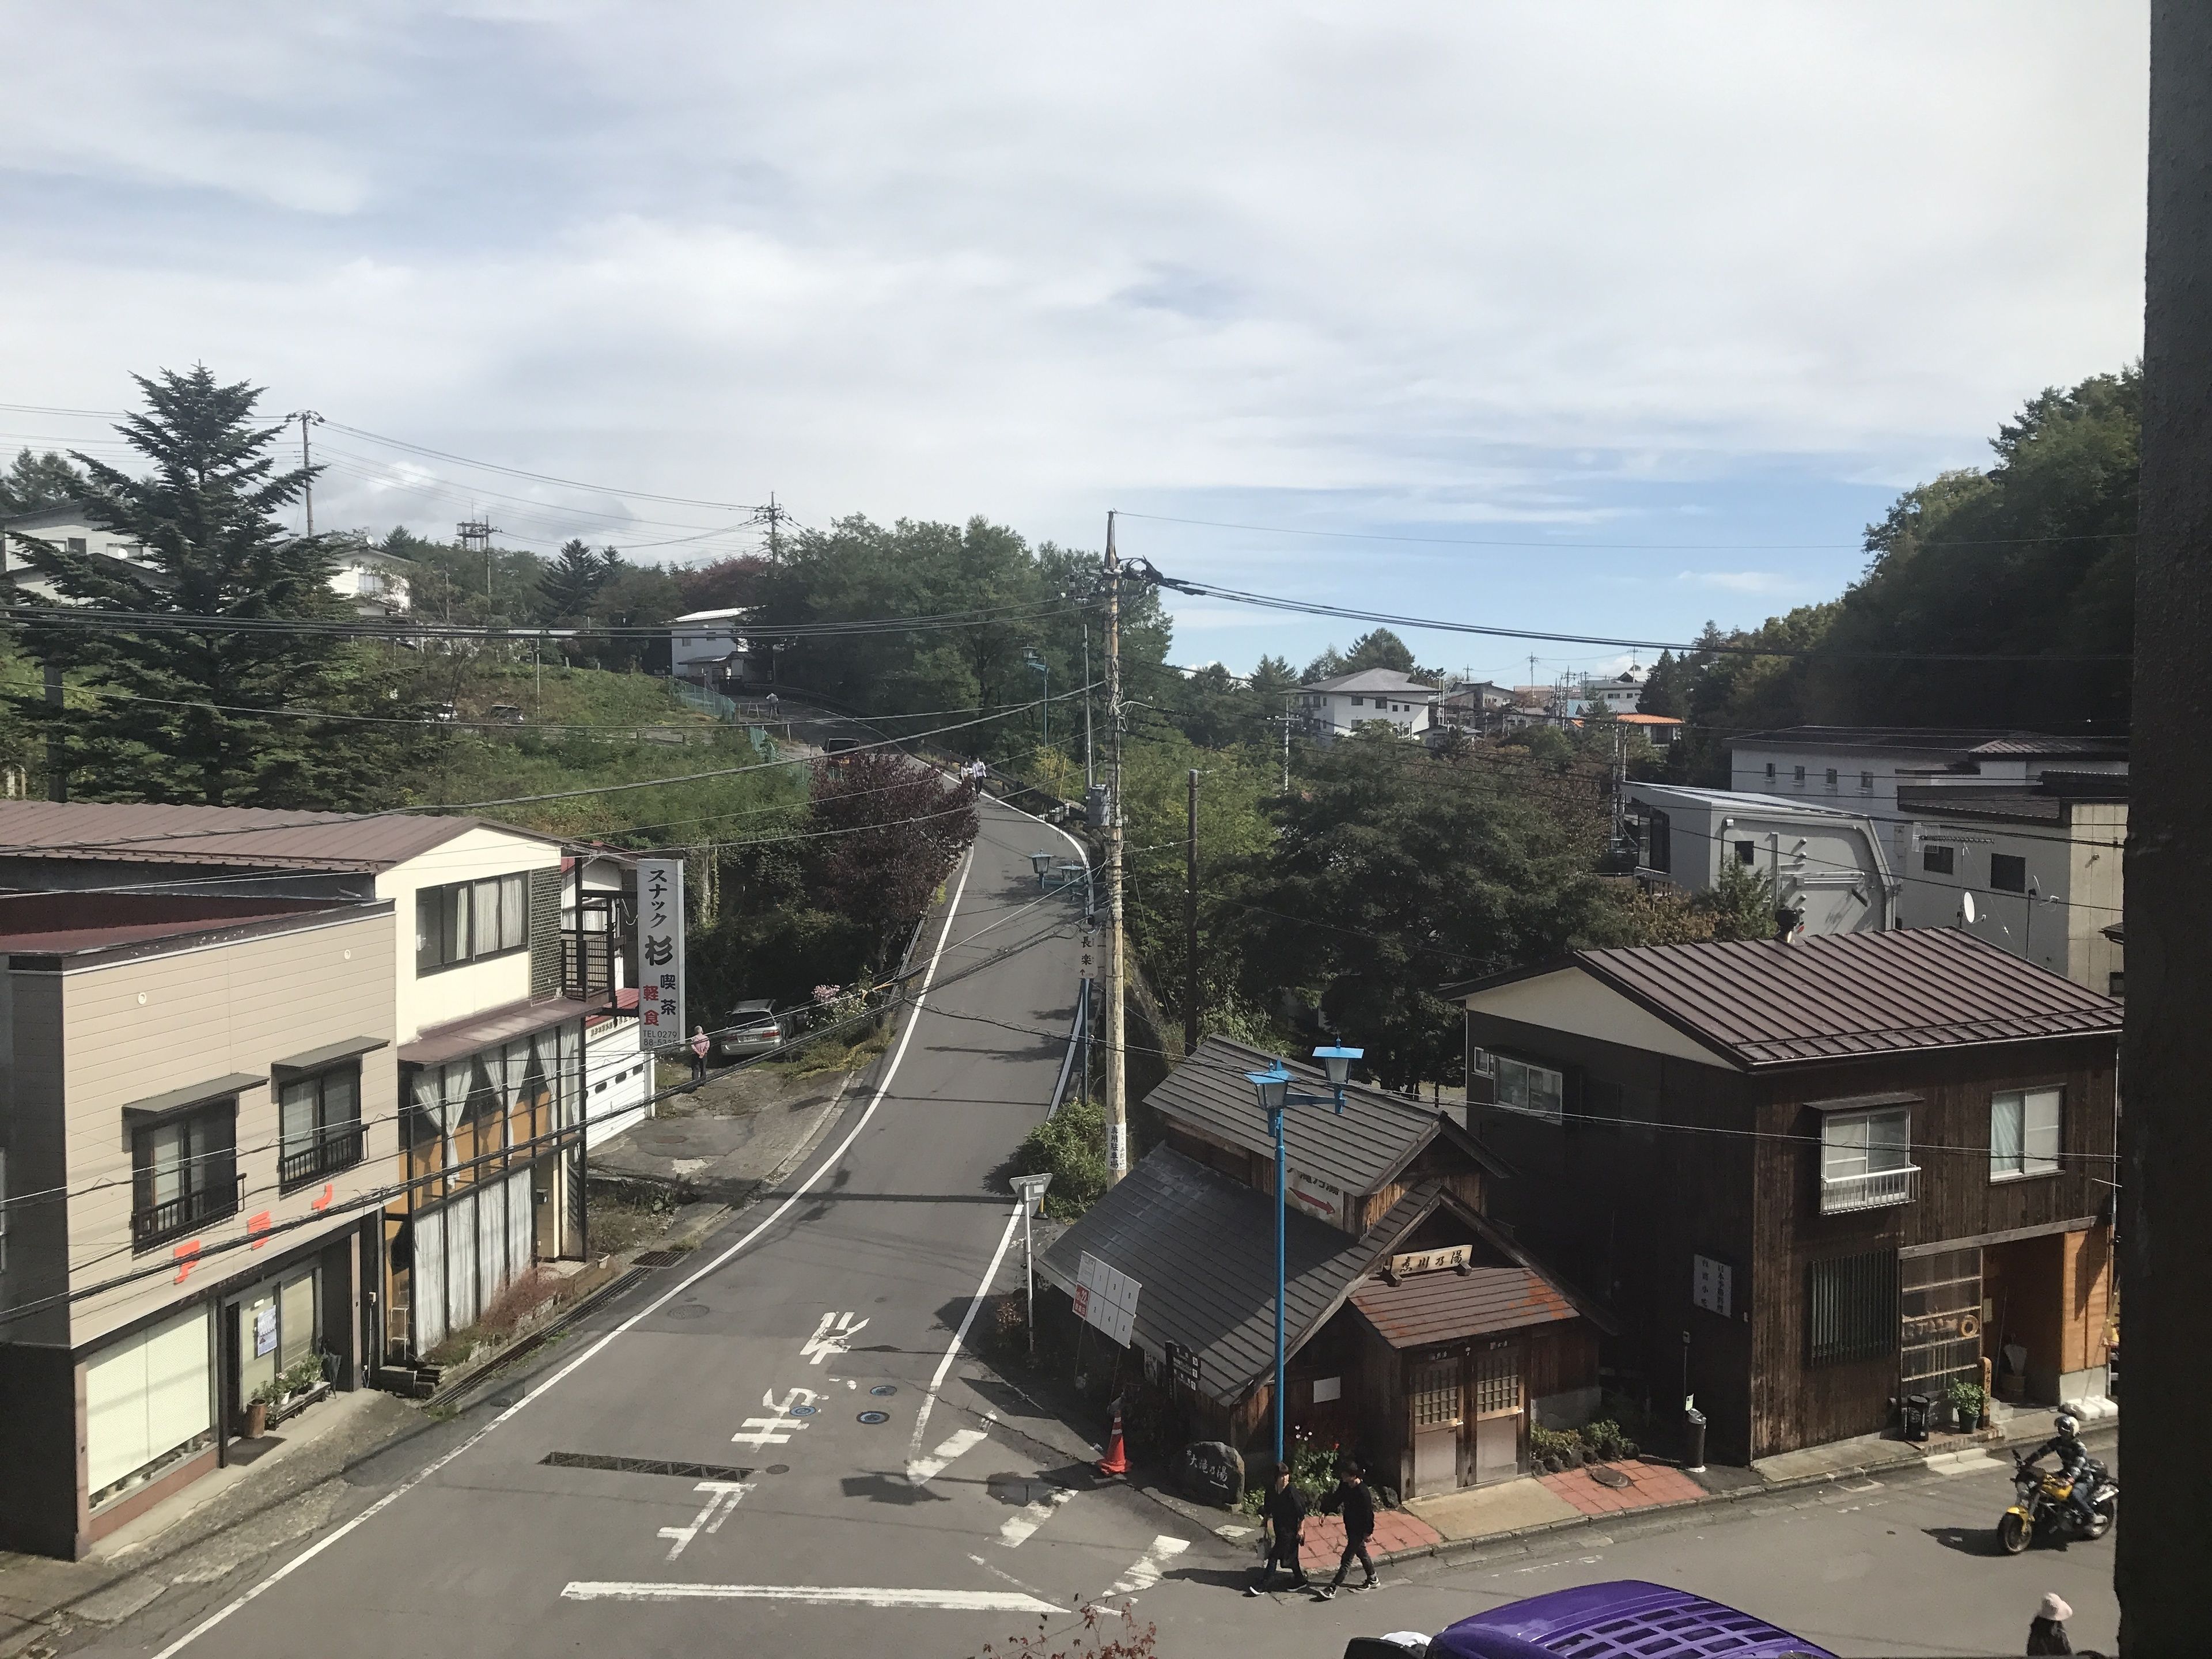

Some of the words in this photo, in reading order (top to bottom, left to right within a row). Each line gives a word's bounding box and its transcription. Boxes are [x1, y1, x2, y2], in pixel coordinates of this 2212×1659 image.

[647, 869, 667, 929] スナック
[645, 935, 673, 966] 杉
[1081, 936, 1092, 965] 長楽
[643, 985, 660, 1027] 軽食
[660, 974, 676, 1016] 喫茶
[643, 1030, 656, 1038] TEL
[657, 1031, 677, 1039] 0279
[1110, 1125, 1119, 1169] 専用駐車場
